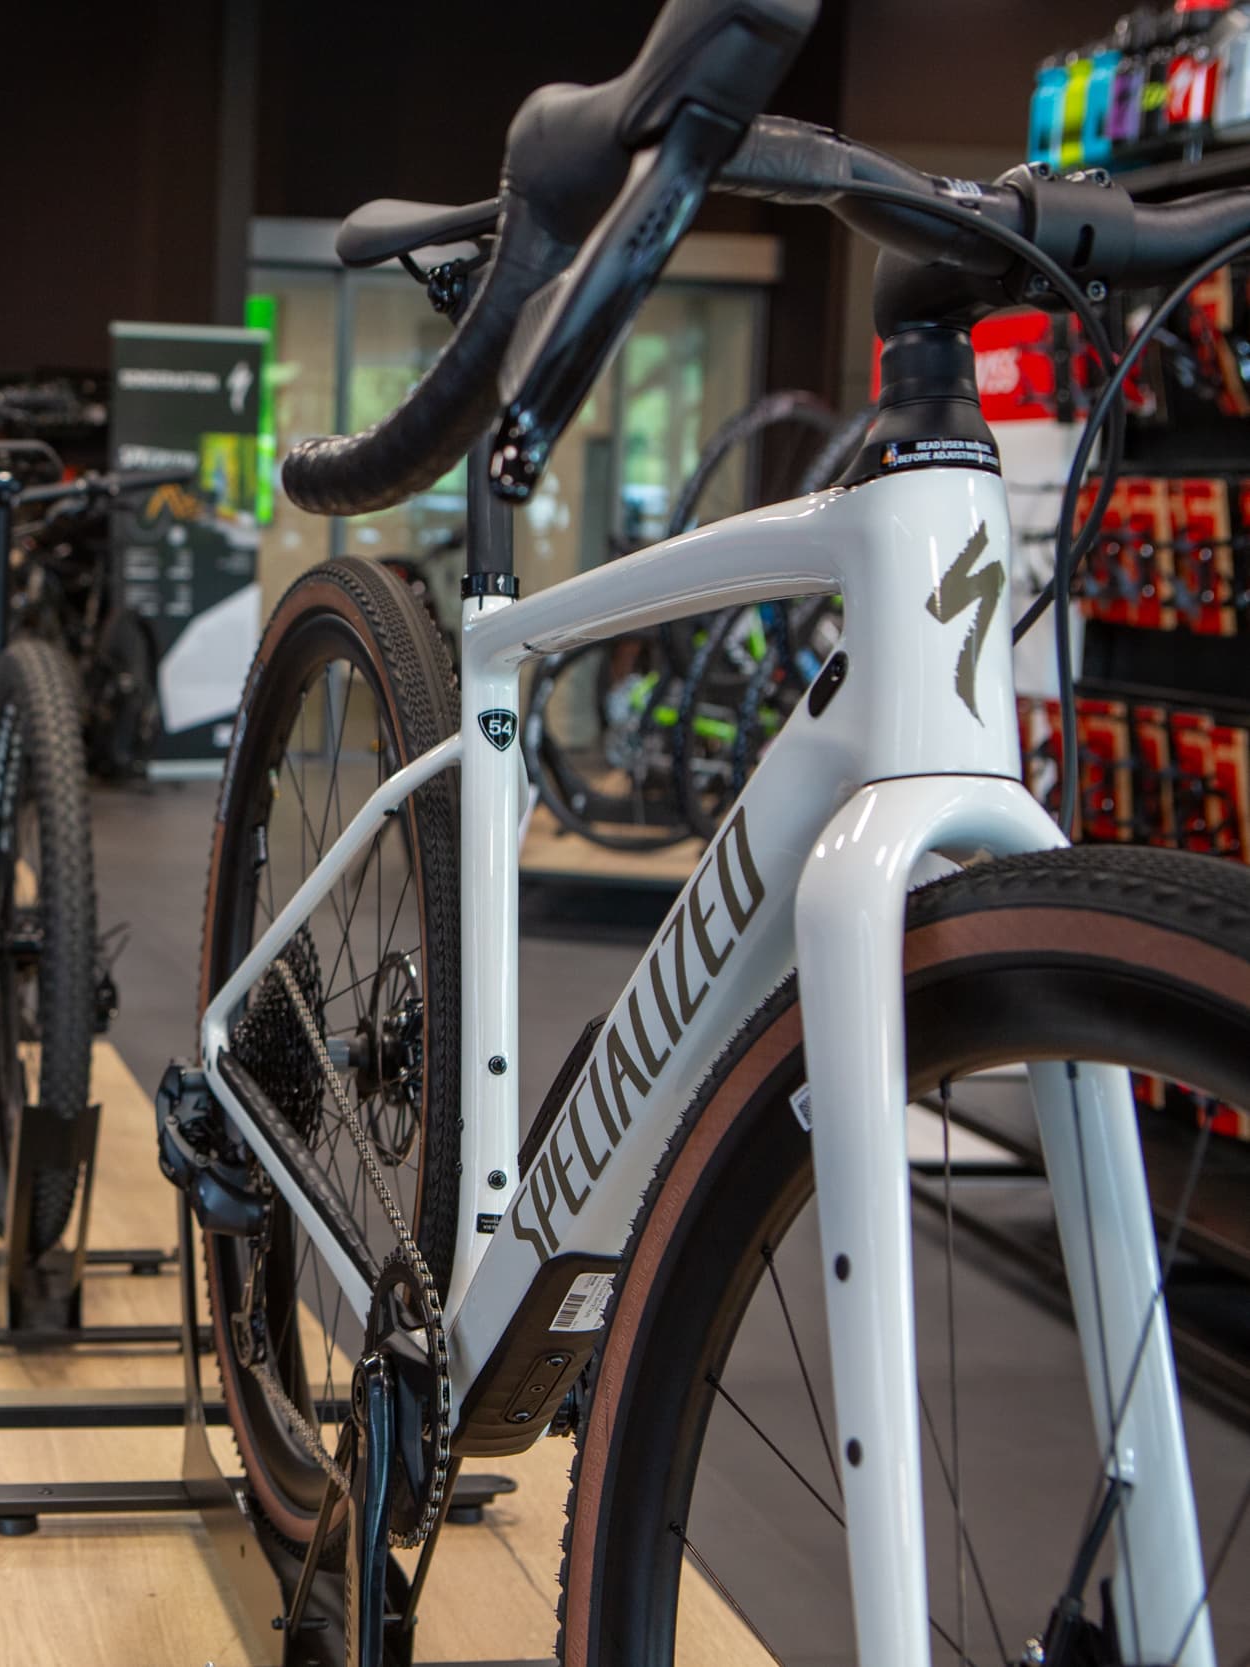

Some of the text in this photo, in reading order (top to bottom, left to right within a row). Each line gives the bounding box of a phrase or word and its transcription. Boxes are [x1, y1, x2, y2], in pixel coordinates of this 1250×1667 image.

[916, 440, 940, 451] READ
[942, 440, 964, 451] USER
[898, 451, 932, 464] BEFORE
[488, 719, 513, 737] 54
[511, 805, 766, 1265] SPECIALIZED
